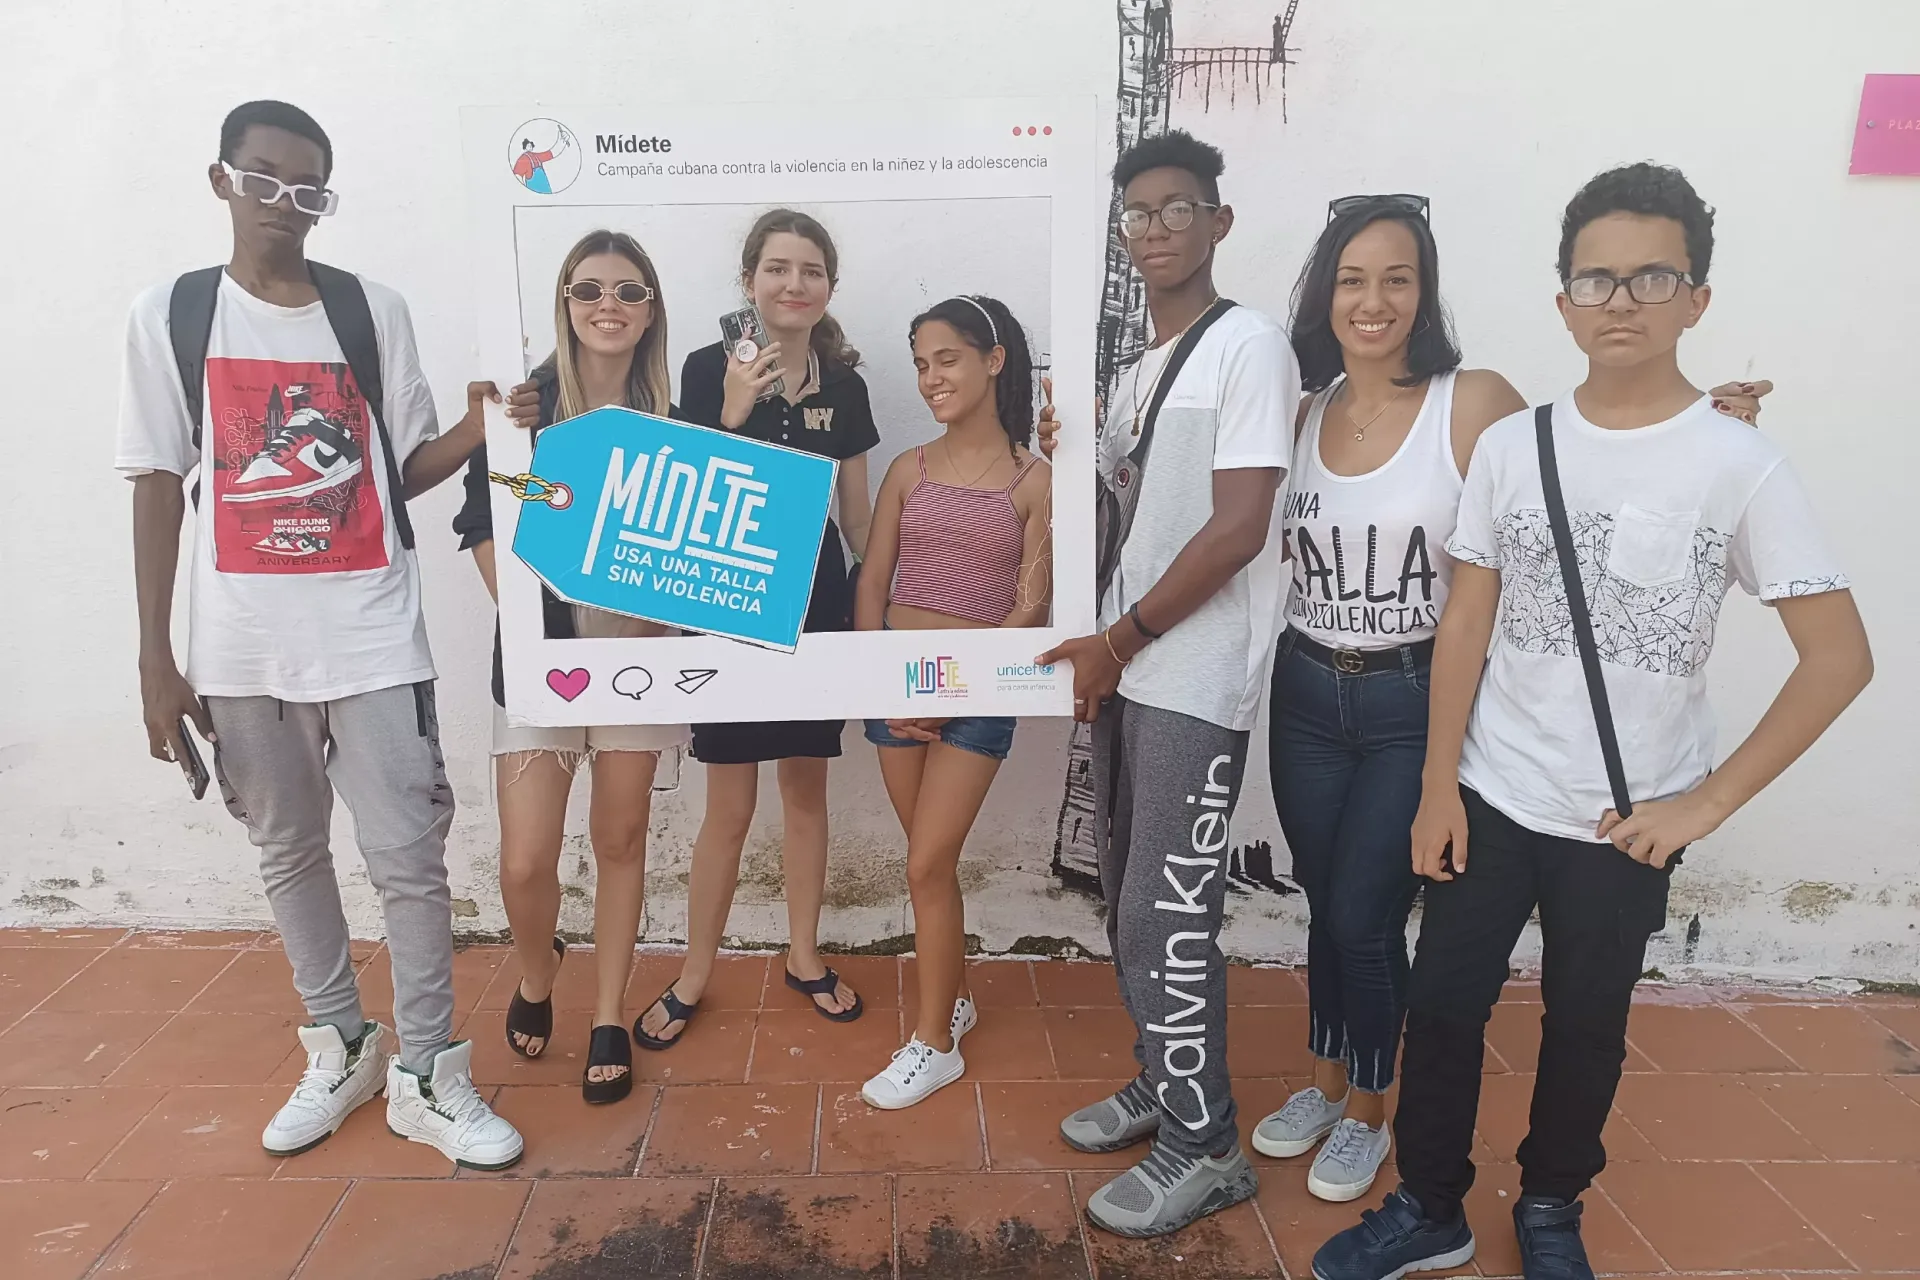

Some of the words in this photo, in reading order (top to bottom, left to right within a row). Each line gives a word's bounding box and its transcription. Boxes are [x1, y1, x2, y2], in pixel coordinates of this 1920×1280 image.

[595, 134, 672, 154] Mídete
[597, 162, 663, 179] Campaña
[667, 160, 718, 175] cubana
[722, 162, 766, 174] contra
[770, 160, 782, 173] la
[786, 158, 846, 173] violencia
[850, 160, 868, 172] en
[872, 158, 884, 171] la
[888, 157, 925, 171] niñez
[929, 159, 938, 173] y
[942, 156, 953, 170] la
[957, 154, 1048, 169] adolescencia
[803, 408, 834, 432] NY
[581, 444, 779, 575] MÍDETE
[1284, 491, 1321, 520] UNA
[273, 518, 298, 526] NIKE
[300, 518, 329, 526] DUNK
[273, 525, 331, 534] CHICAGO
[257, 556, 351, 566] ANIVERSARY
[613, 544, 653, 568] USA
[661, 555, 701, 579] UNA
[709, 566, 767, 594] TALLA
[608, 565, 643, 587] SIN
[652, 573, 762, 615] VIOLENCIA
[1307, 601, 1438, 635] VIOLENCIAS
[905, 656, 968, 698] MÍDETE
[996, 662, 1038, 676] unicef
[1154, 753, 1232, 914] Klein
[1146, 931, 1210, 1131] Calvin
